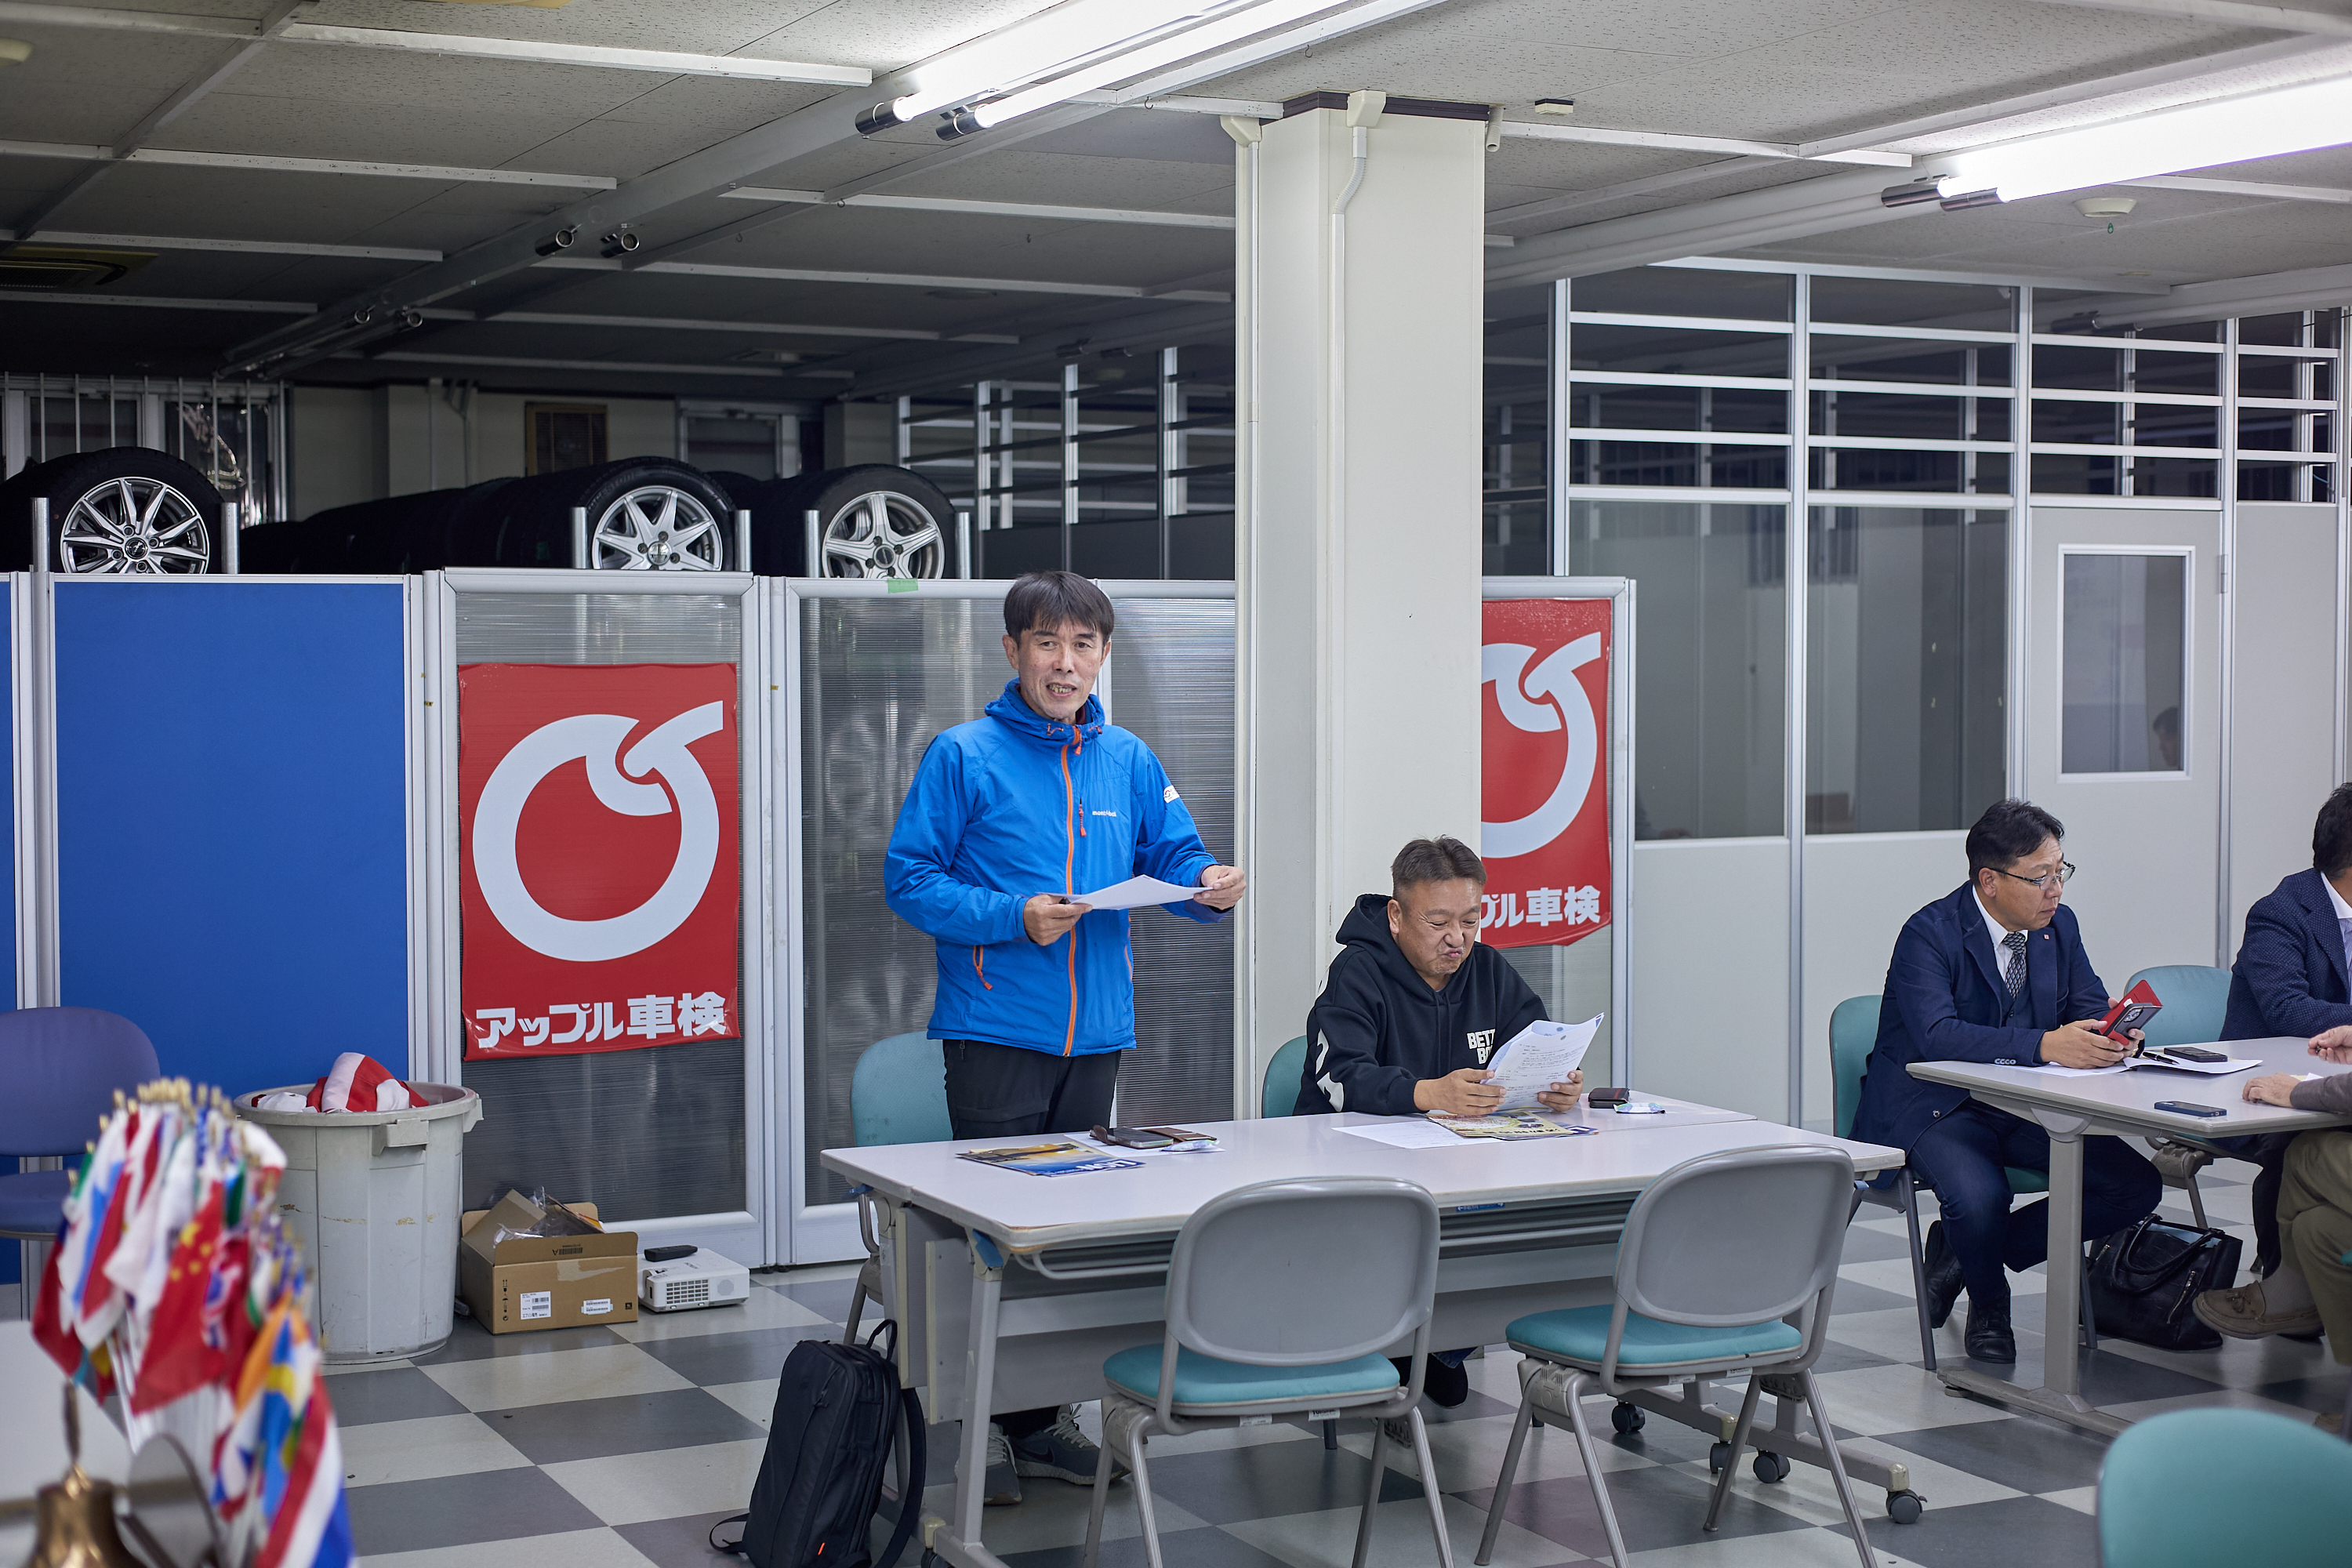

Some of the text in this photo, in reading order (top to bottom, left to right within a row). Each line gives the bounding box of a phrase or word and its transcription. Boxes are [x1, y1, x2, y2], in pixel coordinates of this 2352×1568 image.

[1480, 885, 1601, 928] プル車検
[476, 991, 726, 1049] アップル車検
